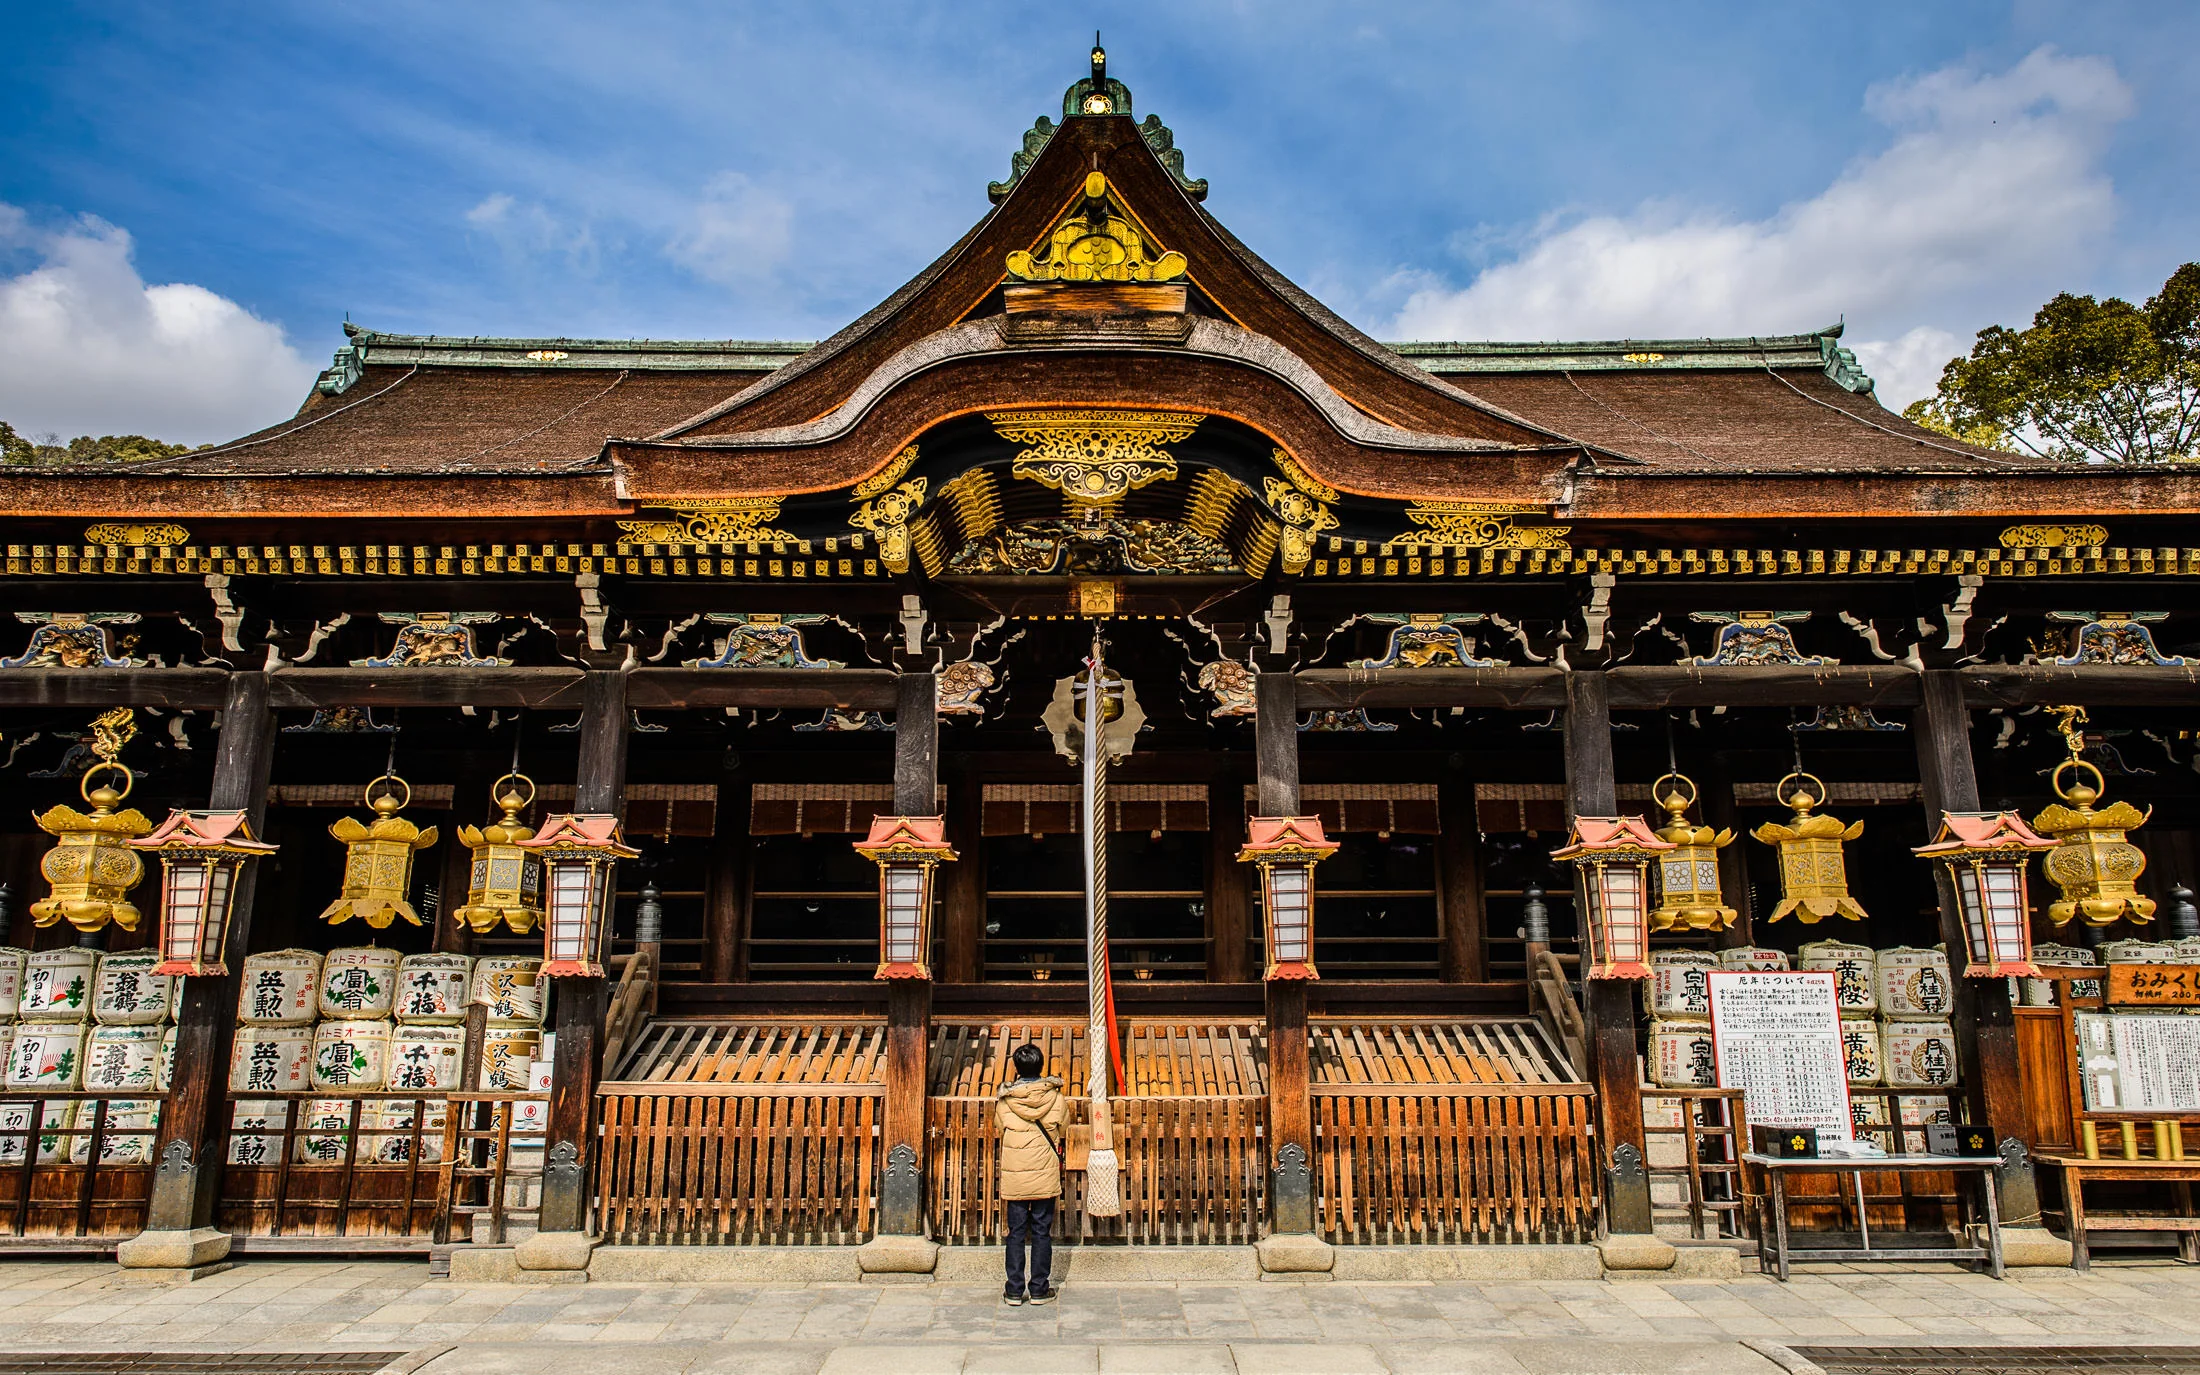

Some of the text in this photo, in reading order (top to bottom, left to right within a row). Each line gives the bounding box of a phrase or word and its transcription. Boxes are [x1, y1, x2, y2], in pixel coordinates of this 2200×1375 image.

[340, 955, 380, 964] トミオー
[1739, 976, 1805, 985] 厄年について
[30, 969, 49, 1008] 初日の出
[341, 967, 369, 1010] 富翁
[411, 972, 438, 1015] 千福
[495, 974, 516, 1017] 沢の鶴
[1680, 967, 1709, 1013] 白鷹
[1835, 960, 1863, 1006] 黄桜
[1920, 967, 1941, 1014] 月桂冠
[326, 1028, 366, 1038] トミオー
[19, 1039, 40, 1080] 初日の出
[328, 1040, 355, 1085] 富翁
[401, 1045, 430, 1088] 千福
[489, 1044, 512, 1088] 沢の鶴
[1686, 1036, 1715, 1084] 白鷹
[1844, 1033, 1872, 1080] 黄桜
[1925, 1038, 1946, 1084] 月桂冠
[1094, 1111, 1104, 1141] 奉納
